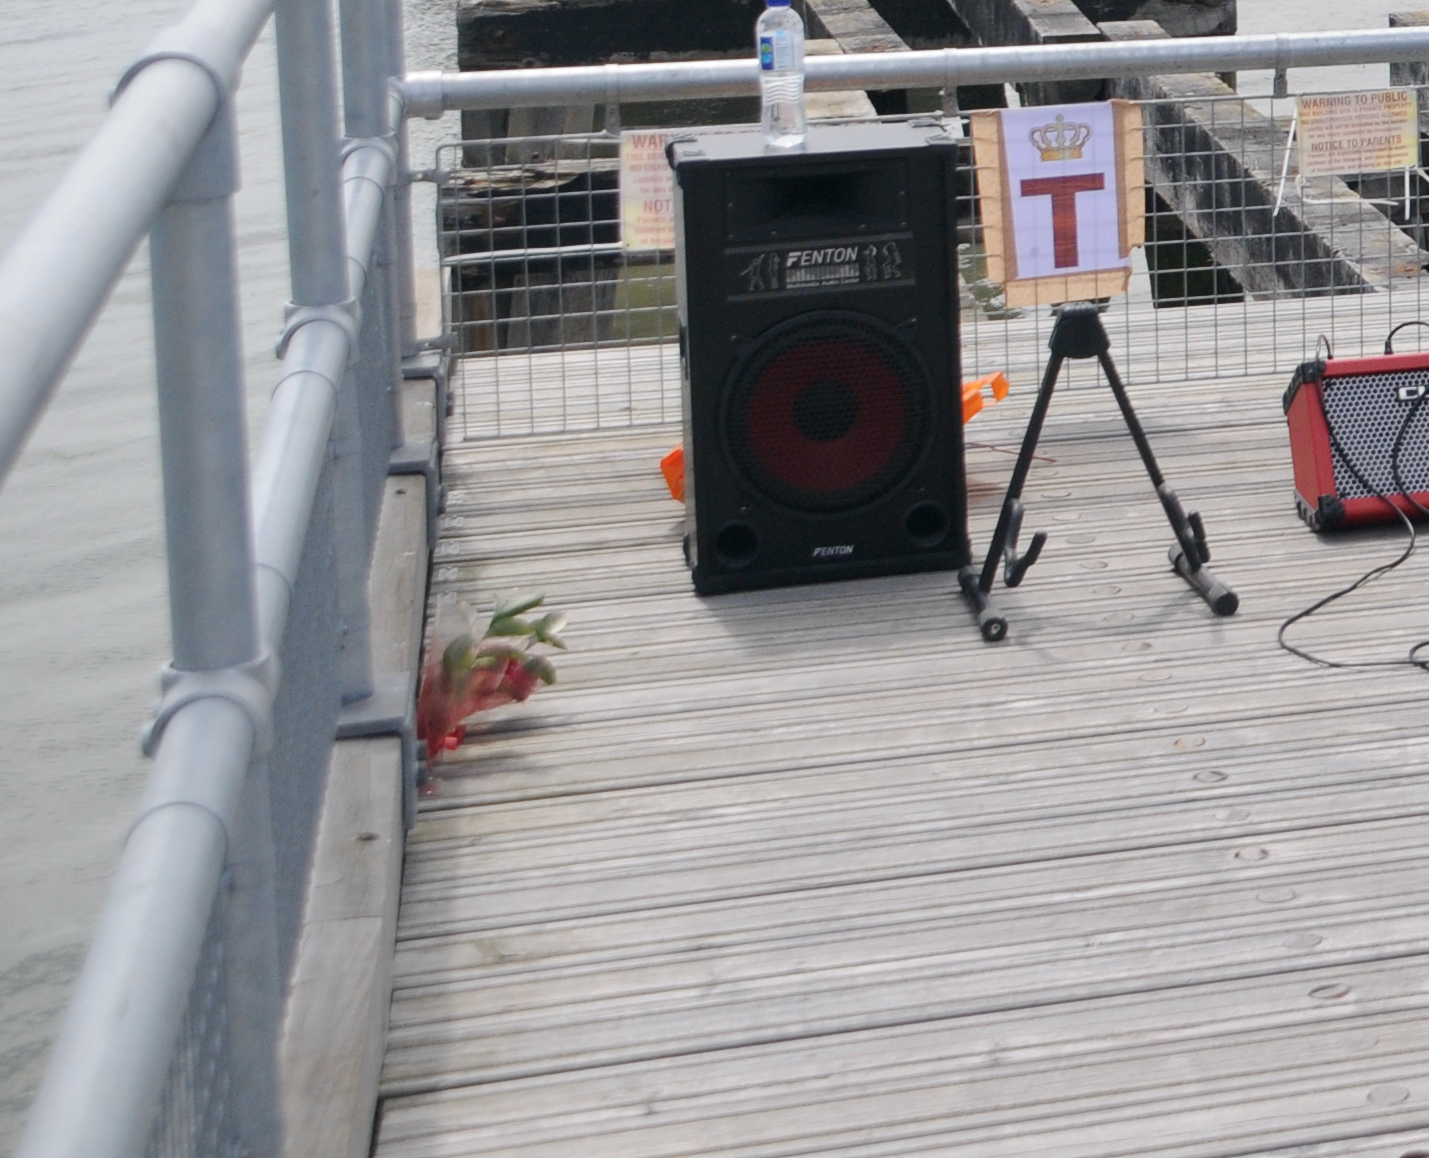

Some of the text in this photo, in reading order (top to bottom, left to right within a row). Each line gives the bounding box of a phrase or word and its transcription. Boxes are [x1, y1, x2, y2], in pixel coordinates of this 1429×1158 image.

[1301, 91, 1407, 109] WARNING TO PUBLIC
[1312, 135, 1402, 152] NOTICE TO PARENTS
[644, 199, 672, 212] NOT
[1020, 172, 1104, 268] T
[786, 246, 858, 267] FENTON
[813, 545, 853, 556] FENTON
